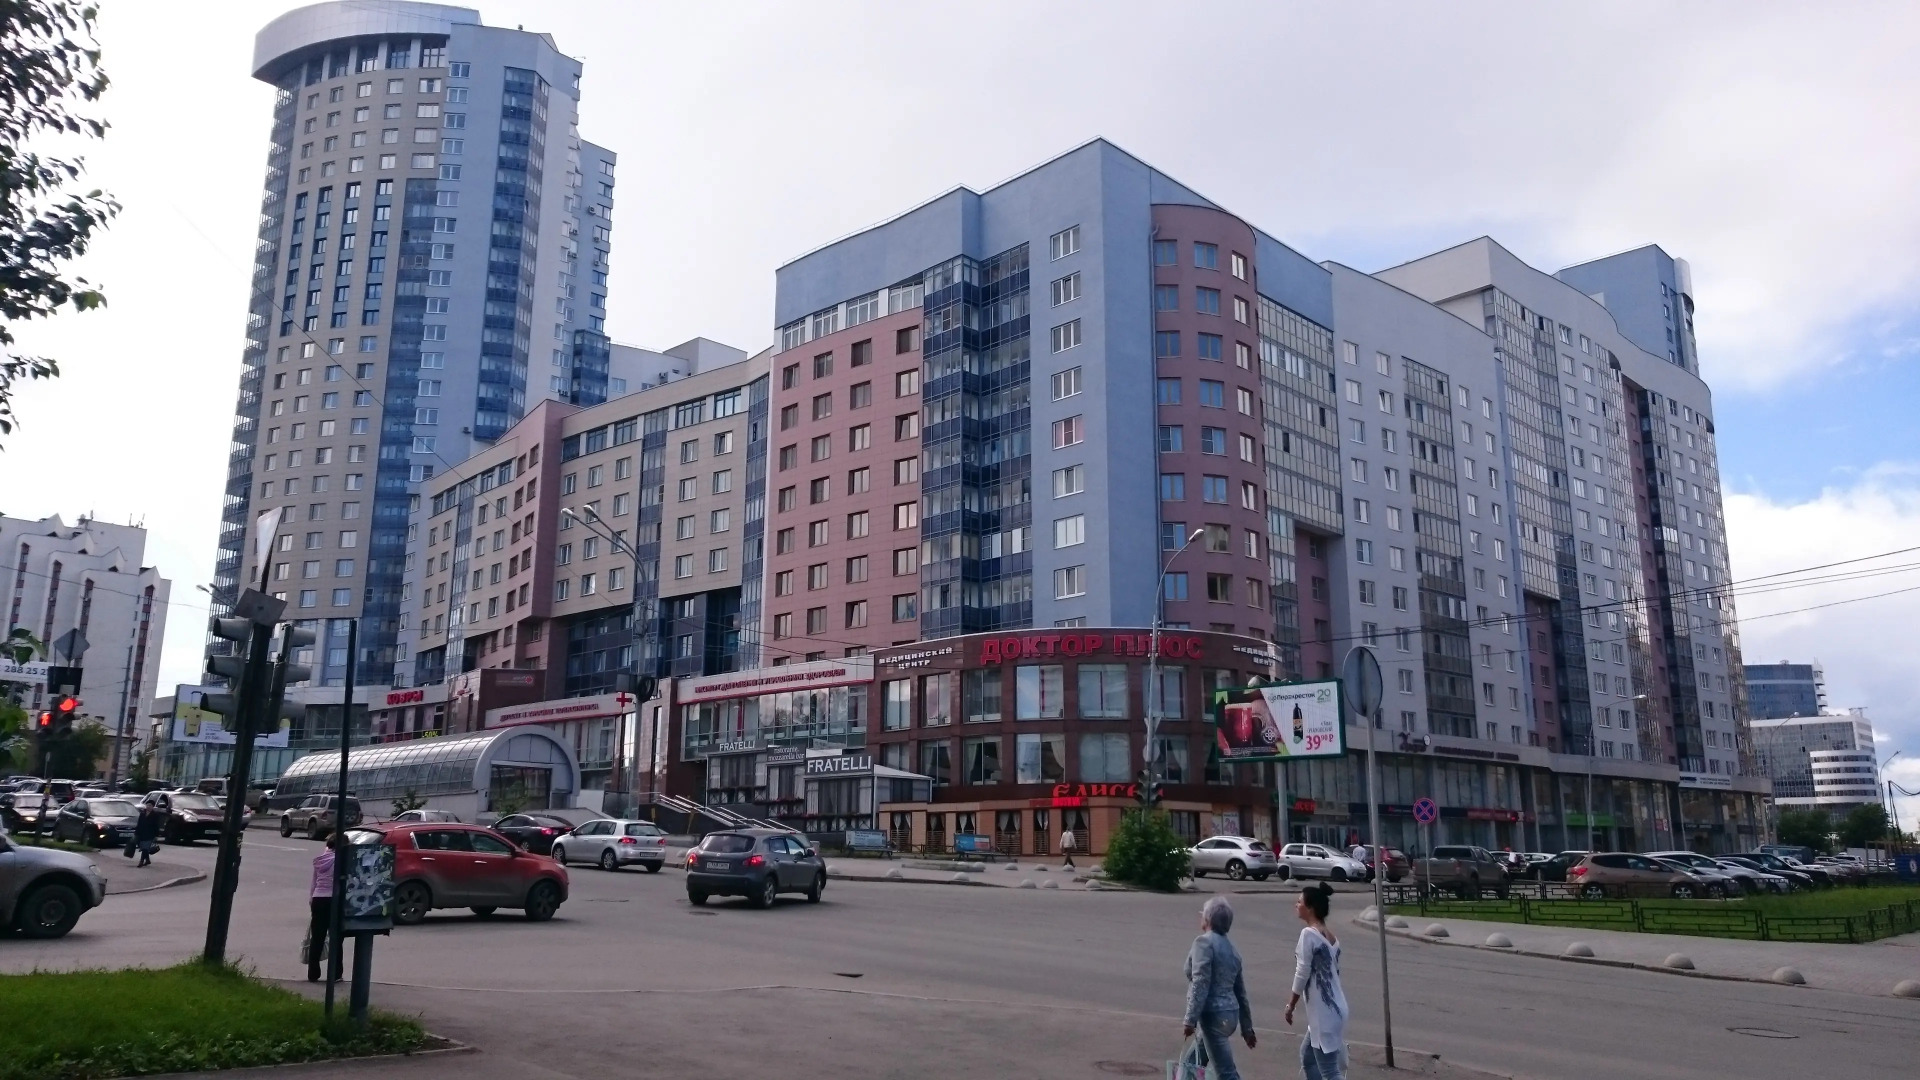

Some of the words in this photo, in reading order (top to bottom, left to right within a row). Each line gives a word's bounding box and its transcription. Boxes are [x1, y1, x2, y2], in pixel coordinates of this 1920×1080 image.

[879, 646, 953, 664] МЕДИЦИНСКИЙ
[980, 634, 1103, 665] ДОКТОР
[1113, 634, 1204, 659] ПЛЮС
[4, 665, 23, 674] 288
[26, 667, 38, 675] 25
[898, 659, 931, 670] ЦЕНТР
[386, 690, 424, 705] КОВРЫ
[719, 740, 756, 751] FRATELLI
[807, 755, 872, 773] FRATELLI
